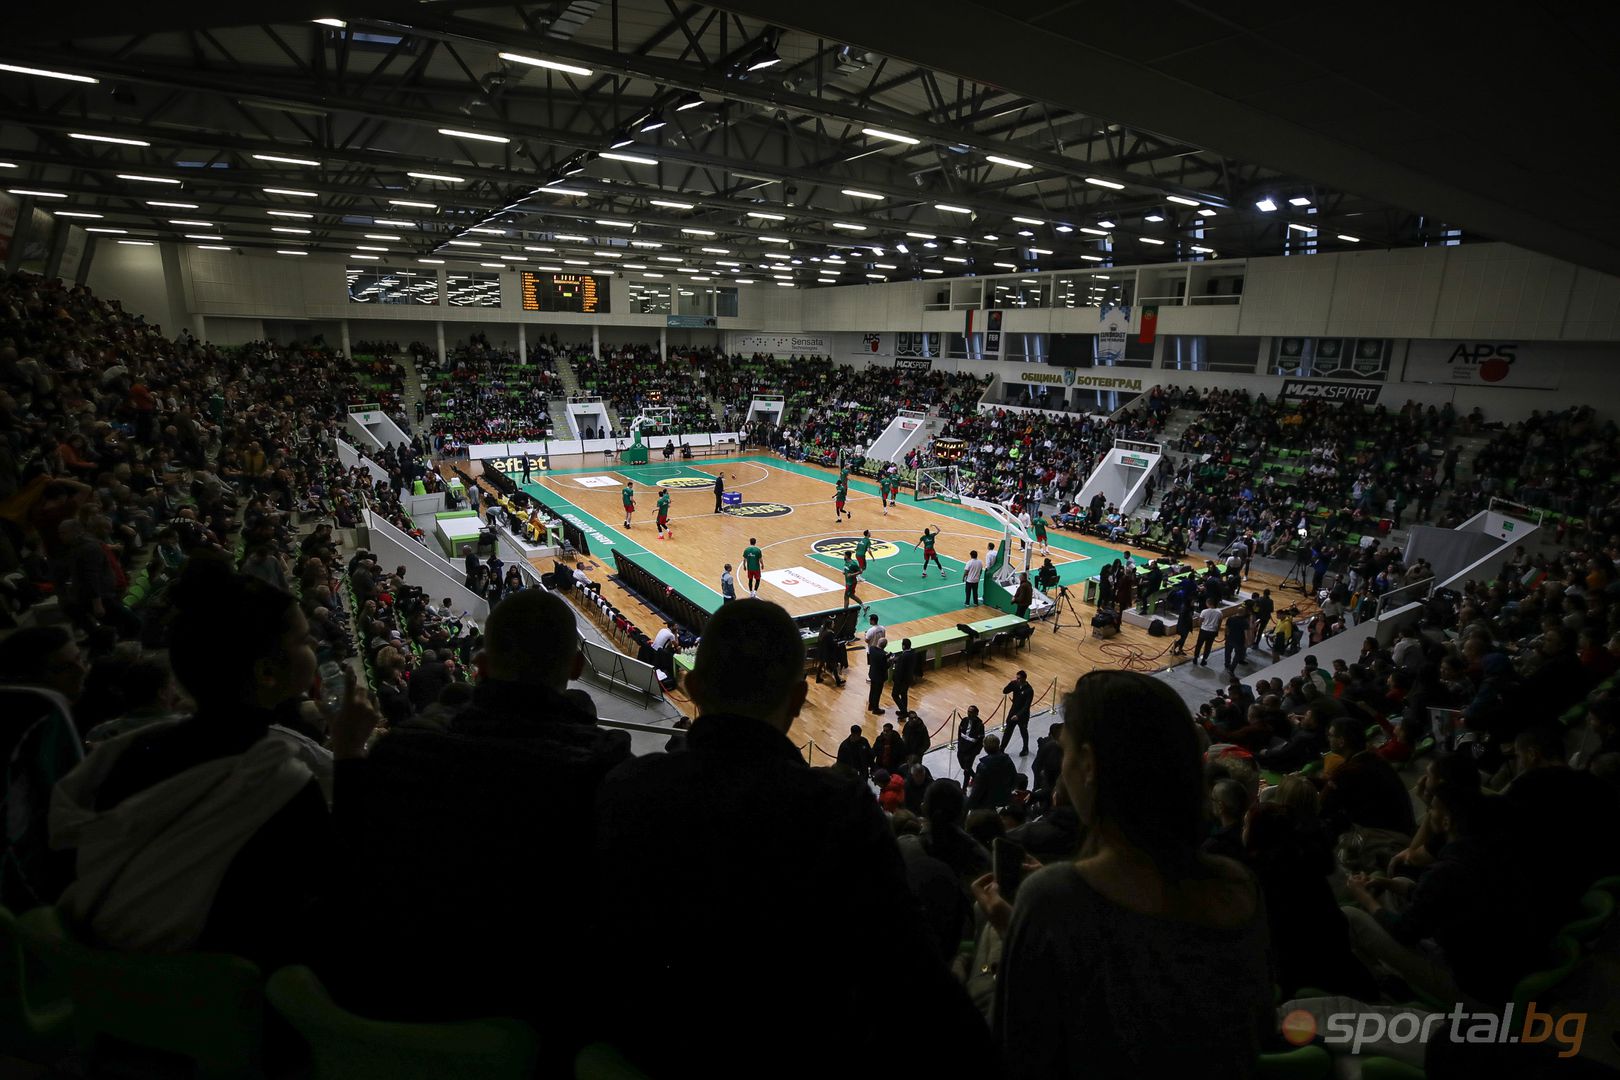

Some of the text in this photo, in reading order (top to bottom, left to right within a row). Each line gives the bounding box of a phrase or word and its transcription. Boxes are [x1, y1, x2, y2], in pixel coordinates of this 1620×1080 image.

[791, 337, 823, 346] Sensata
[863, 334, 880, 344] APS
[1448, 343, 1518, 365] APS
[1021, 372, 1142, 390] ОБЩИНА БОТЕВГРАД
[1285, 383, 1376, 401] MAXSPORT
